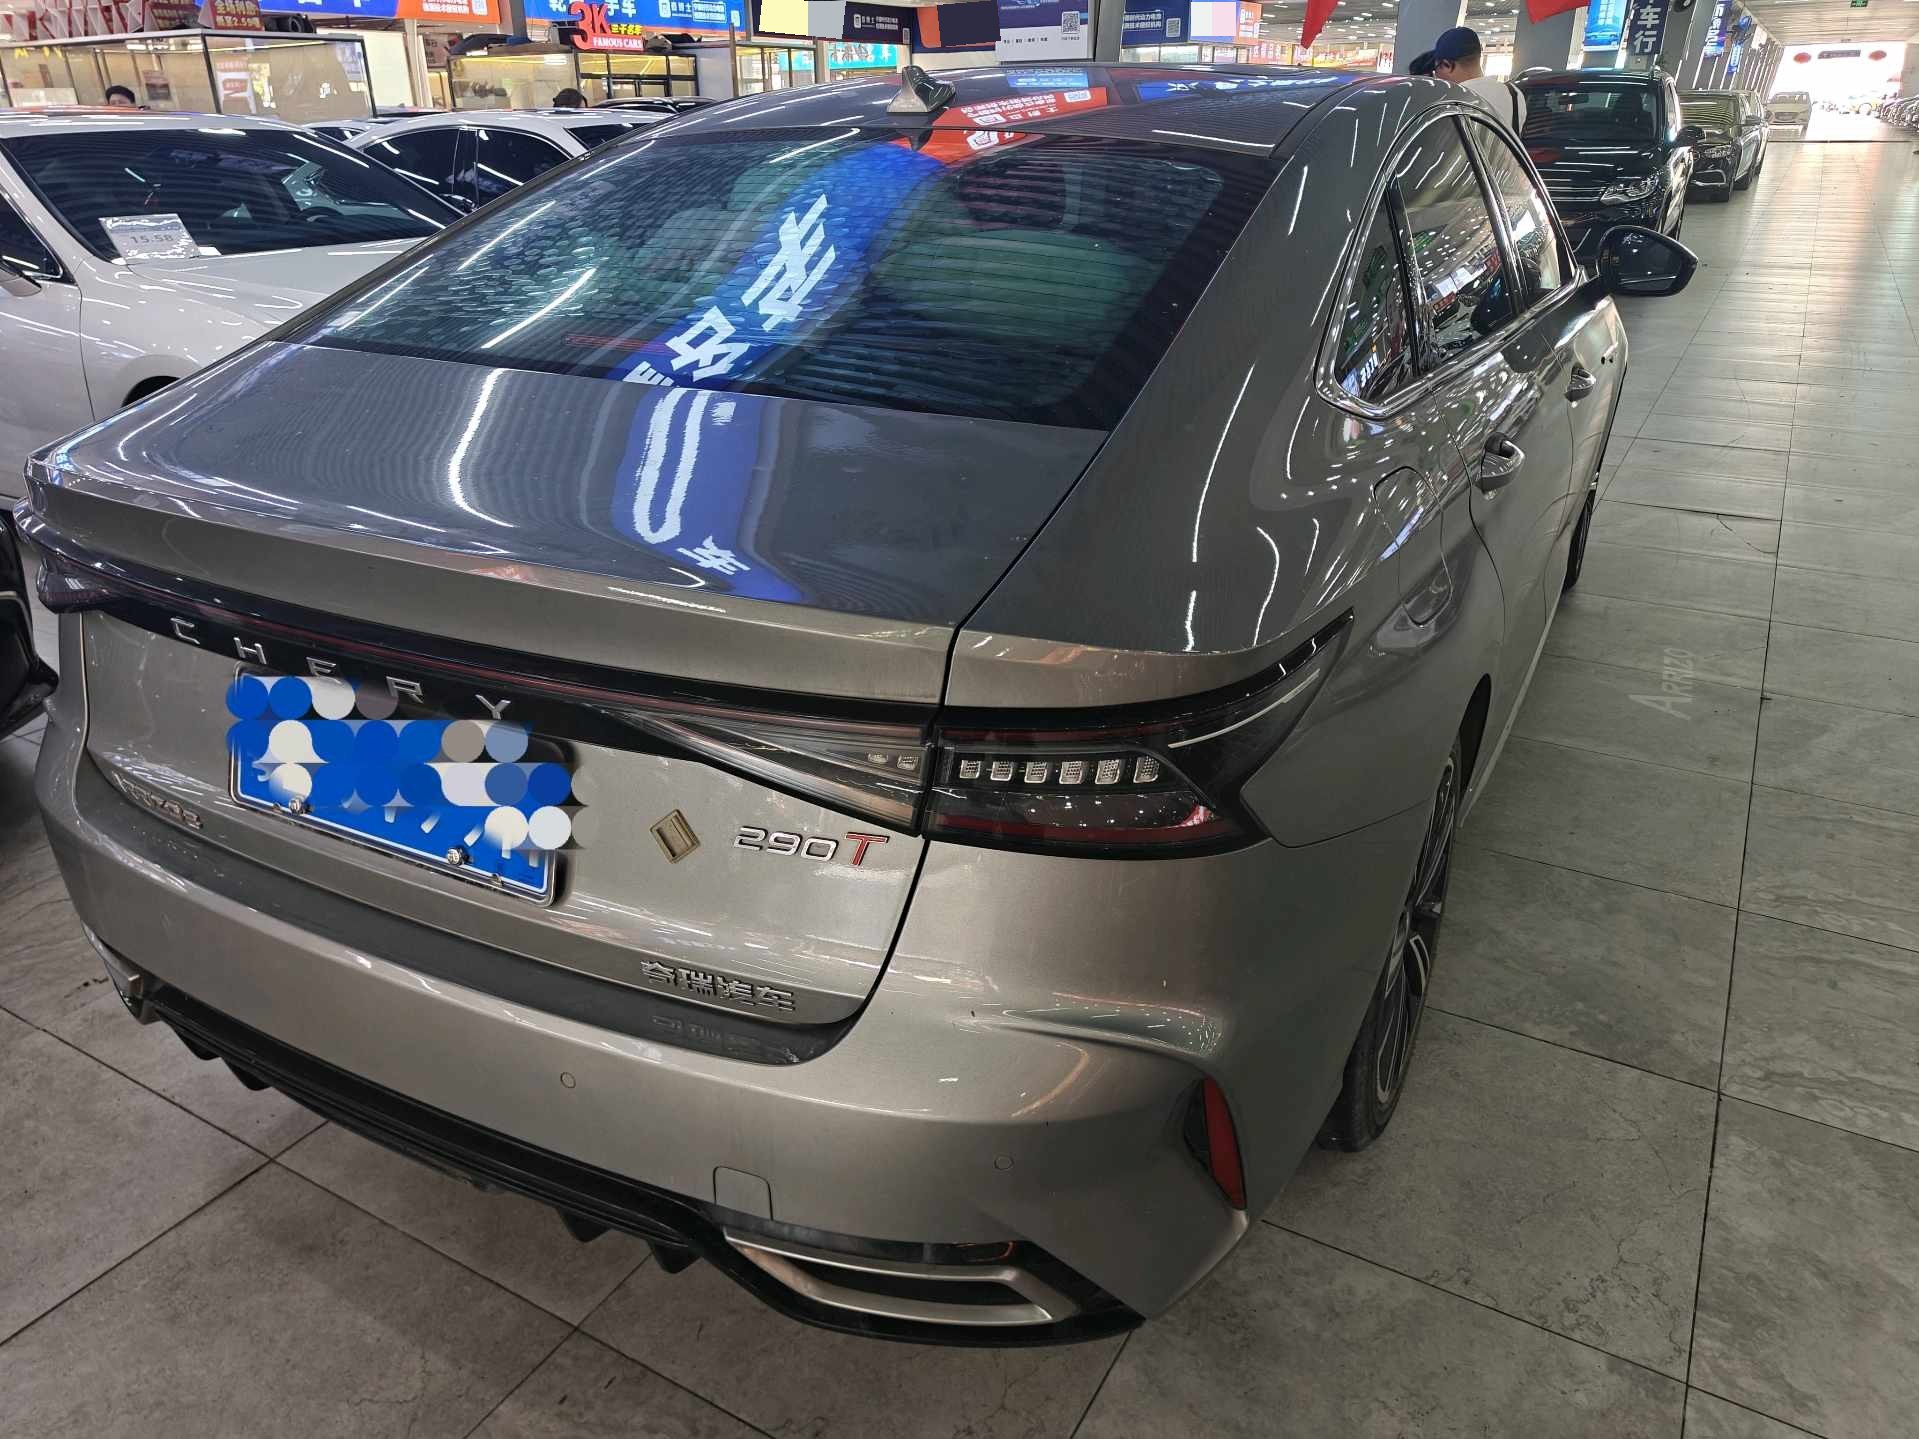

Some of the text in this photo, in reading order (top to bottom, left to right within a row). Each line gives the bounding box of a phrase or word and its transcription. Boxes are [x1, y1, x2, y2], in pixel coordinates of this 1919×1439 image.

[569, 1, 611, 50] 3K
[592, 37, 643, 49] FAMOUS CARS
[733, 826, 890, 867] 290T
[640, 960, 797, 1012] 奇瑞汽车
